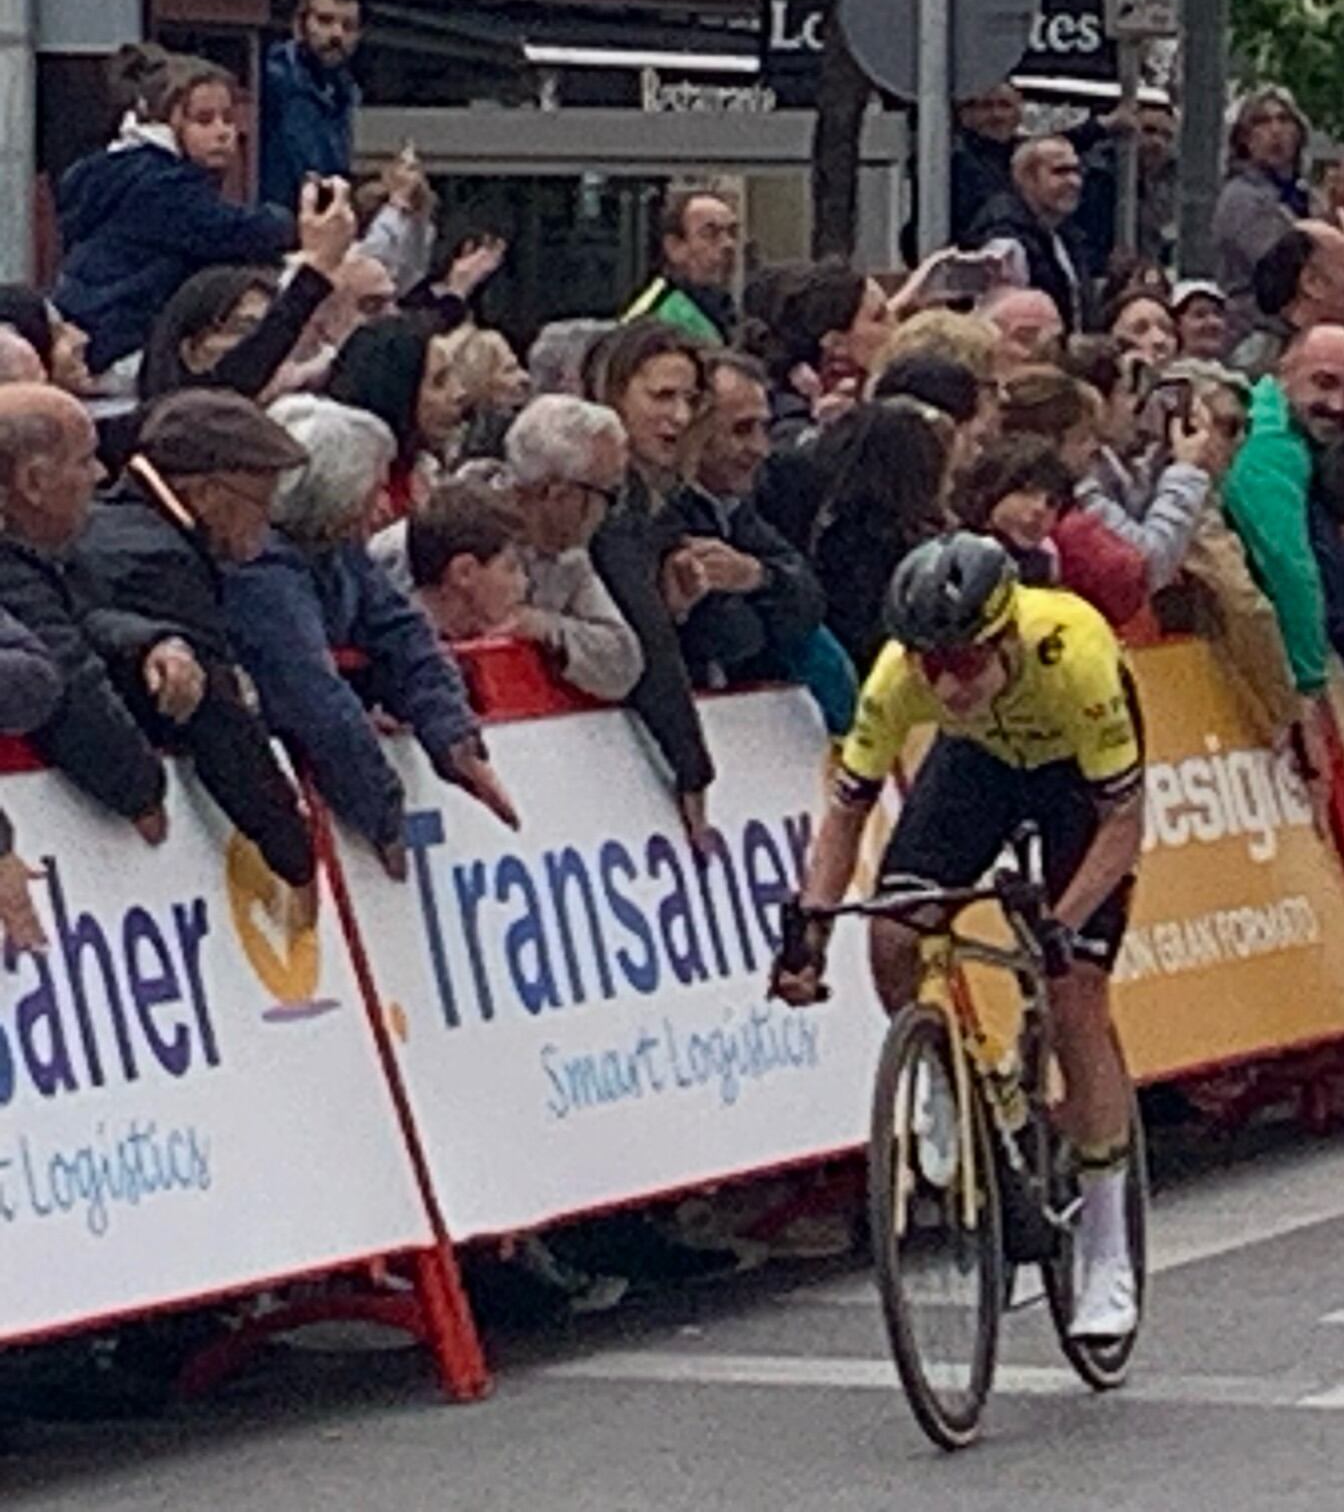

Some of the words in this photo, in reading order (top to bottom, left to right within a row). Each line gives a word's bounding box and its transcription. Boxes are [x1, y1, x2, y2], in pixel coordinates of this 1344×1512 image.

[540, 1034, 663, 1119] Smart
[664, 1002, 820, 1109] Logistics
[26, 1119, 212, 1237] Logistics
